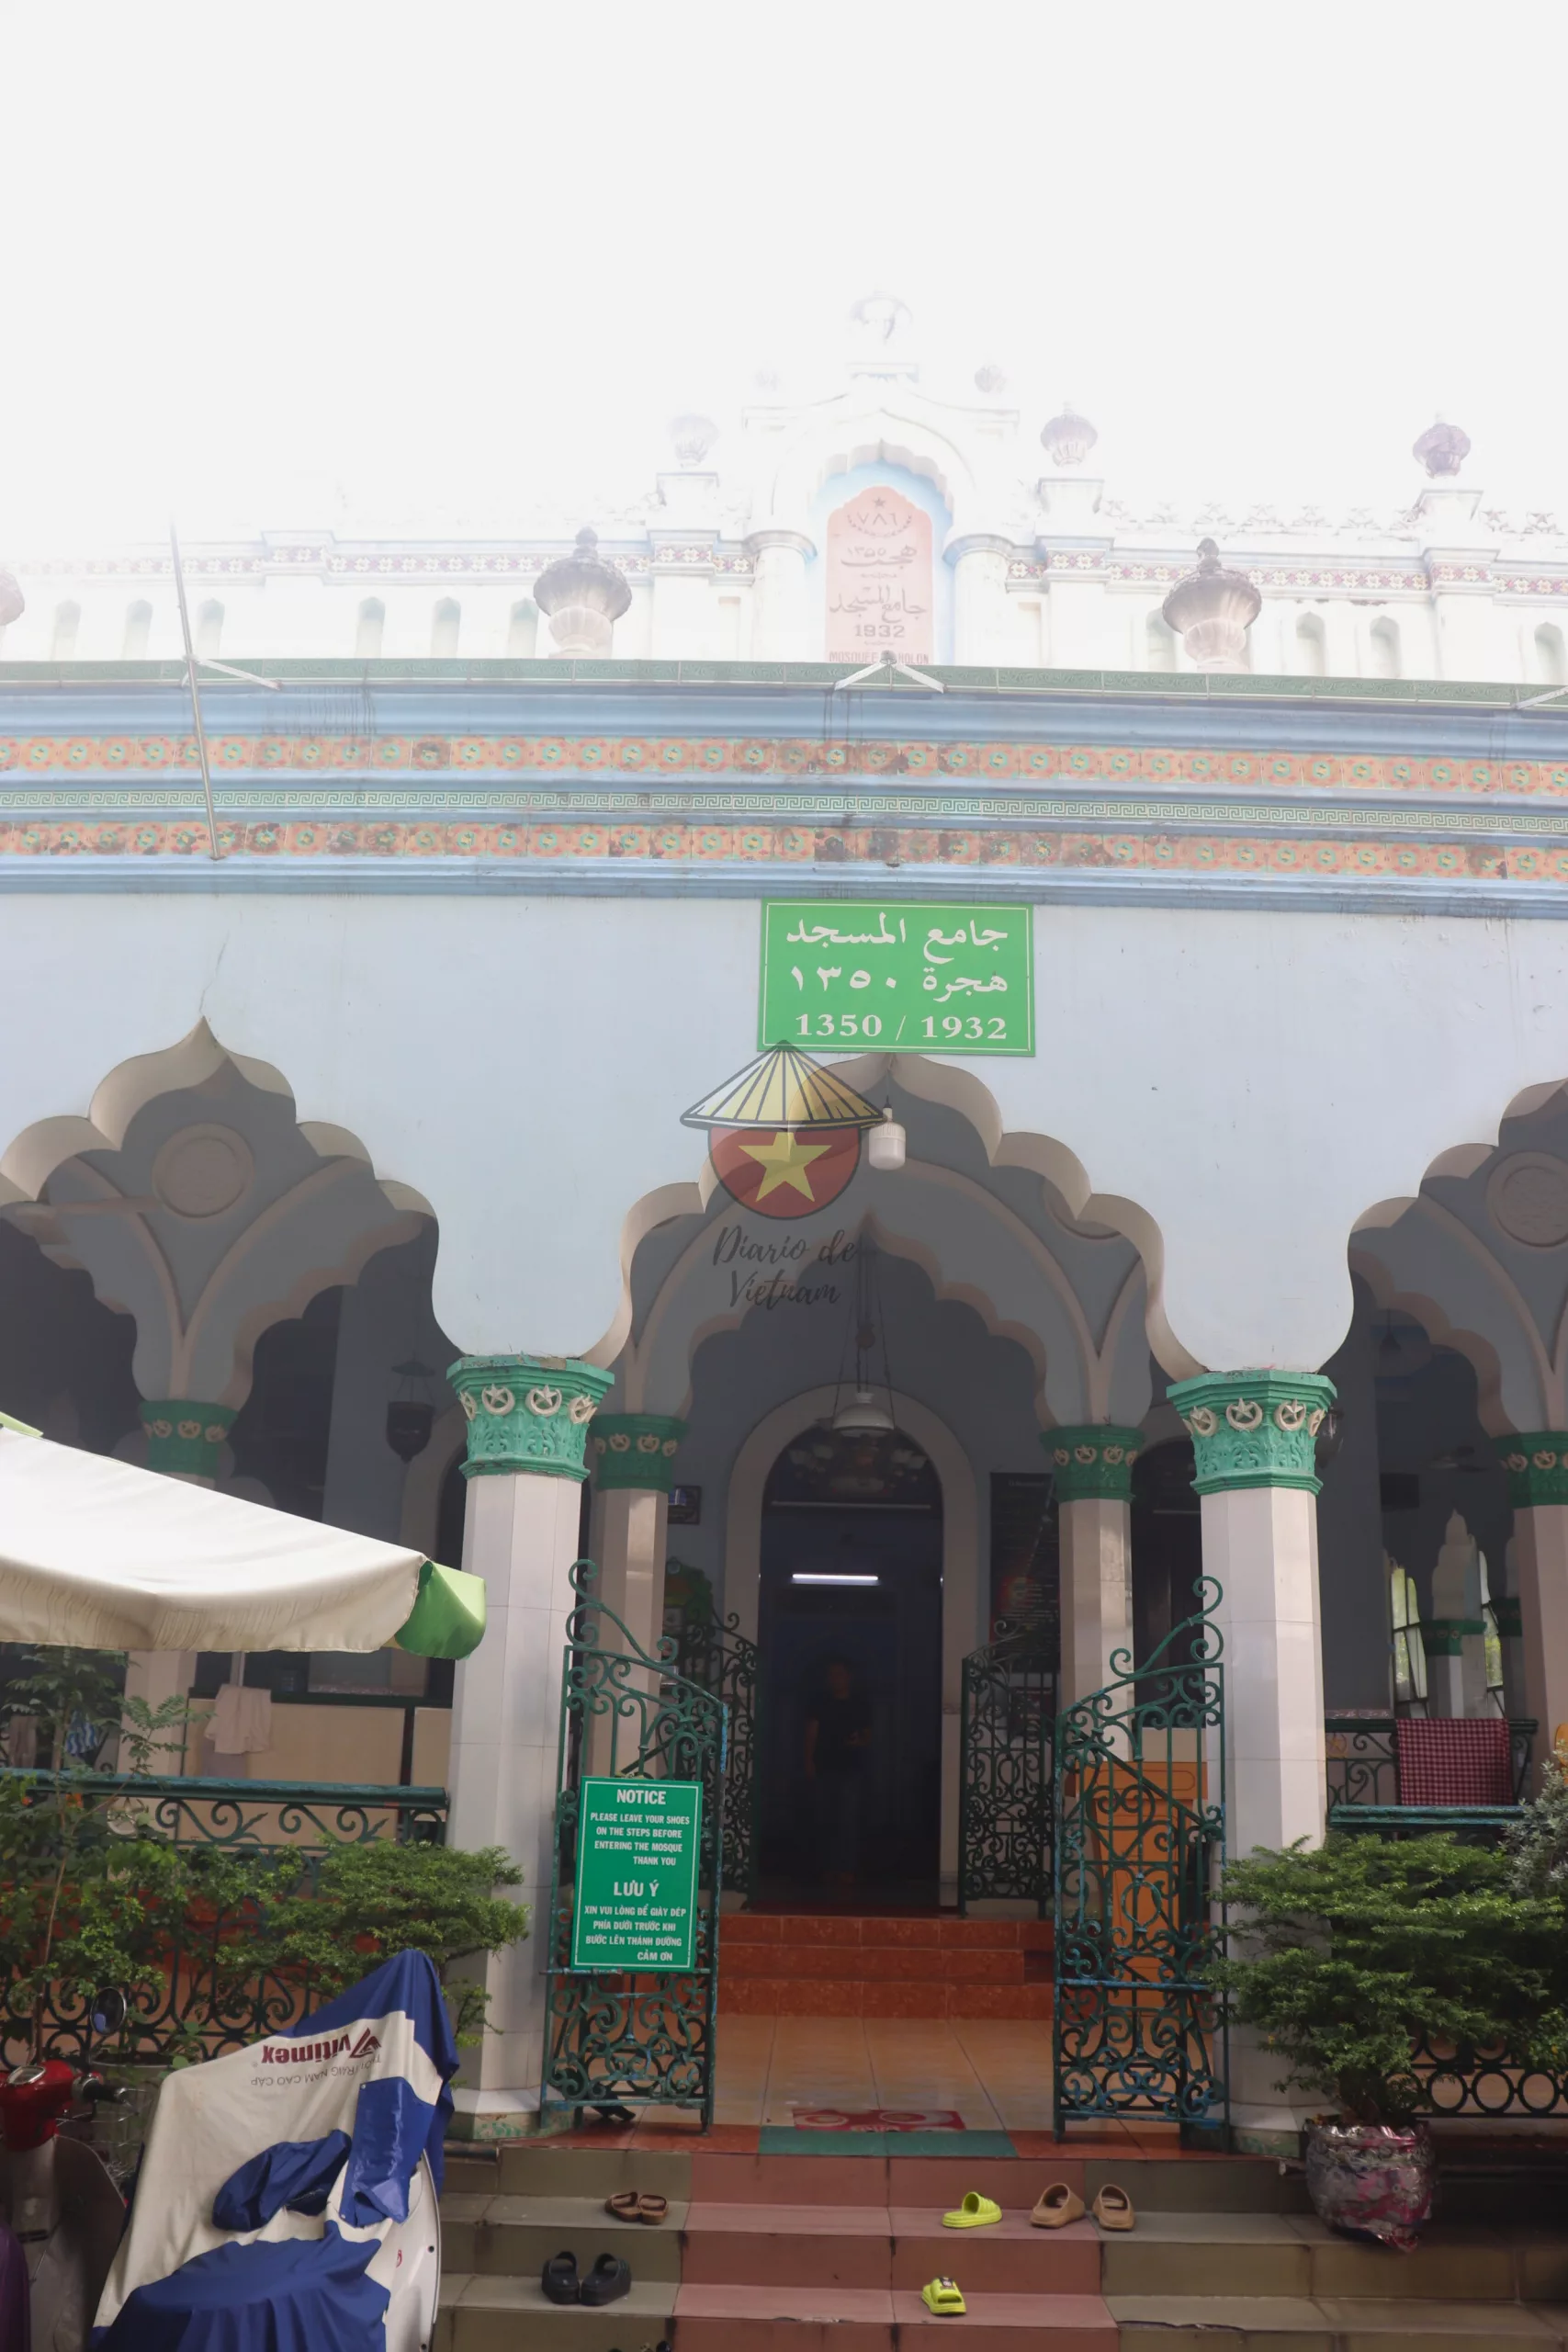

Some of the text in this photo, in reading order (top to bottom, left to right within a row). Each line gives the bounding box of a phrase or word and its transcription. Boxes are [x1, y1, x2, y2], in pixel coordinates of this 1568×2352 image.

[854, 624, 906, 639] 1932
[786, 911, 1009, 965] جامع المسجد
[791, 966, 1009, 1002] هجرة ١٣٥٠
[795, 1014, 883, 1037] 1350
[921, 1015, 1008, 1040] 1932
[616, 1789, 667, 1804] NOTICE
[590, 1812, 690, 1825] PLEASE LEAVE YOUR SHOES
[596, 1826, 682, 1838] ON THE STEPS BEFORE
[594, 1840, 682, 1853] ENTERING THE MOSQUE
[633, 1856, 676, 1866] THANK YOU
[614, 1879, 660, 1897] LƯU Ý
[584, 1905, 598, 1915] XIN
[599, 1905, 613, 1915] VUI
[615, 1905, 635, 1916] LÒNG
[650, 1905, 668, 1917] GIÀY
[593, 1918, 612, 1929] PHÍA
[635, 1920, 660, 1931] TRƯỚC
[662, 1922, 676, 1931] KHI
[585, 1933, 607, 1944] BƯỚC
[609, 1934, 625, 1945] LÊN
[626, 1935, 653, 1946] THÁNH
[637, 1949, 673, 1962] CẢM ƠN
[261, 2033, 351, 2064] vitimex
[276, 2075, 301, 2086] CAO
[304, 2068, 328, 2084] NAM
